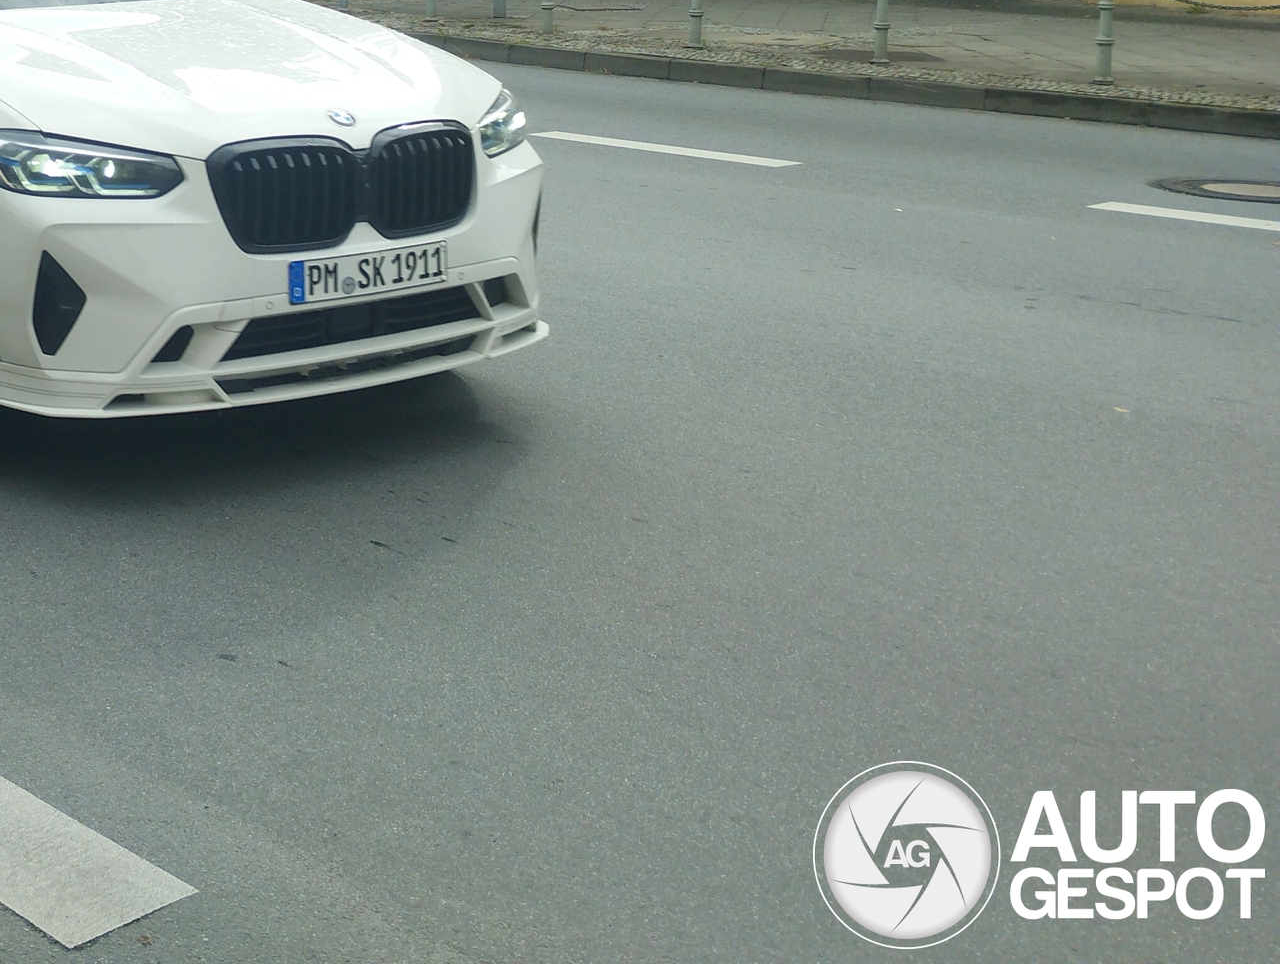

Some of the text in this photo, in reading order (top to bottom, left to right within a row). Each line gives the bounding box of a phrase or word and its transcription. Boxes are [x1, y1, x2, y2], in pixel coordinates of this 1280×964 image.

[308, 246, 443, 295] PM SK 1911
